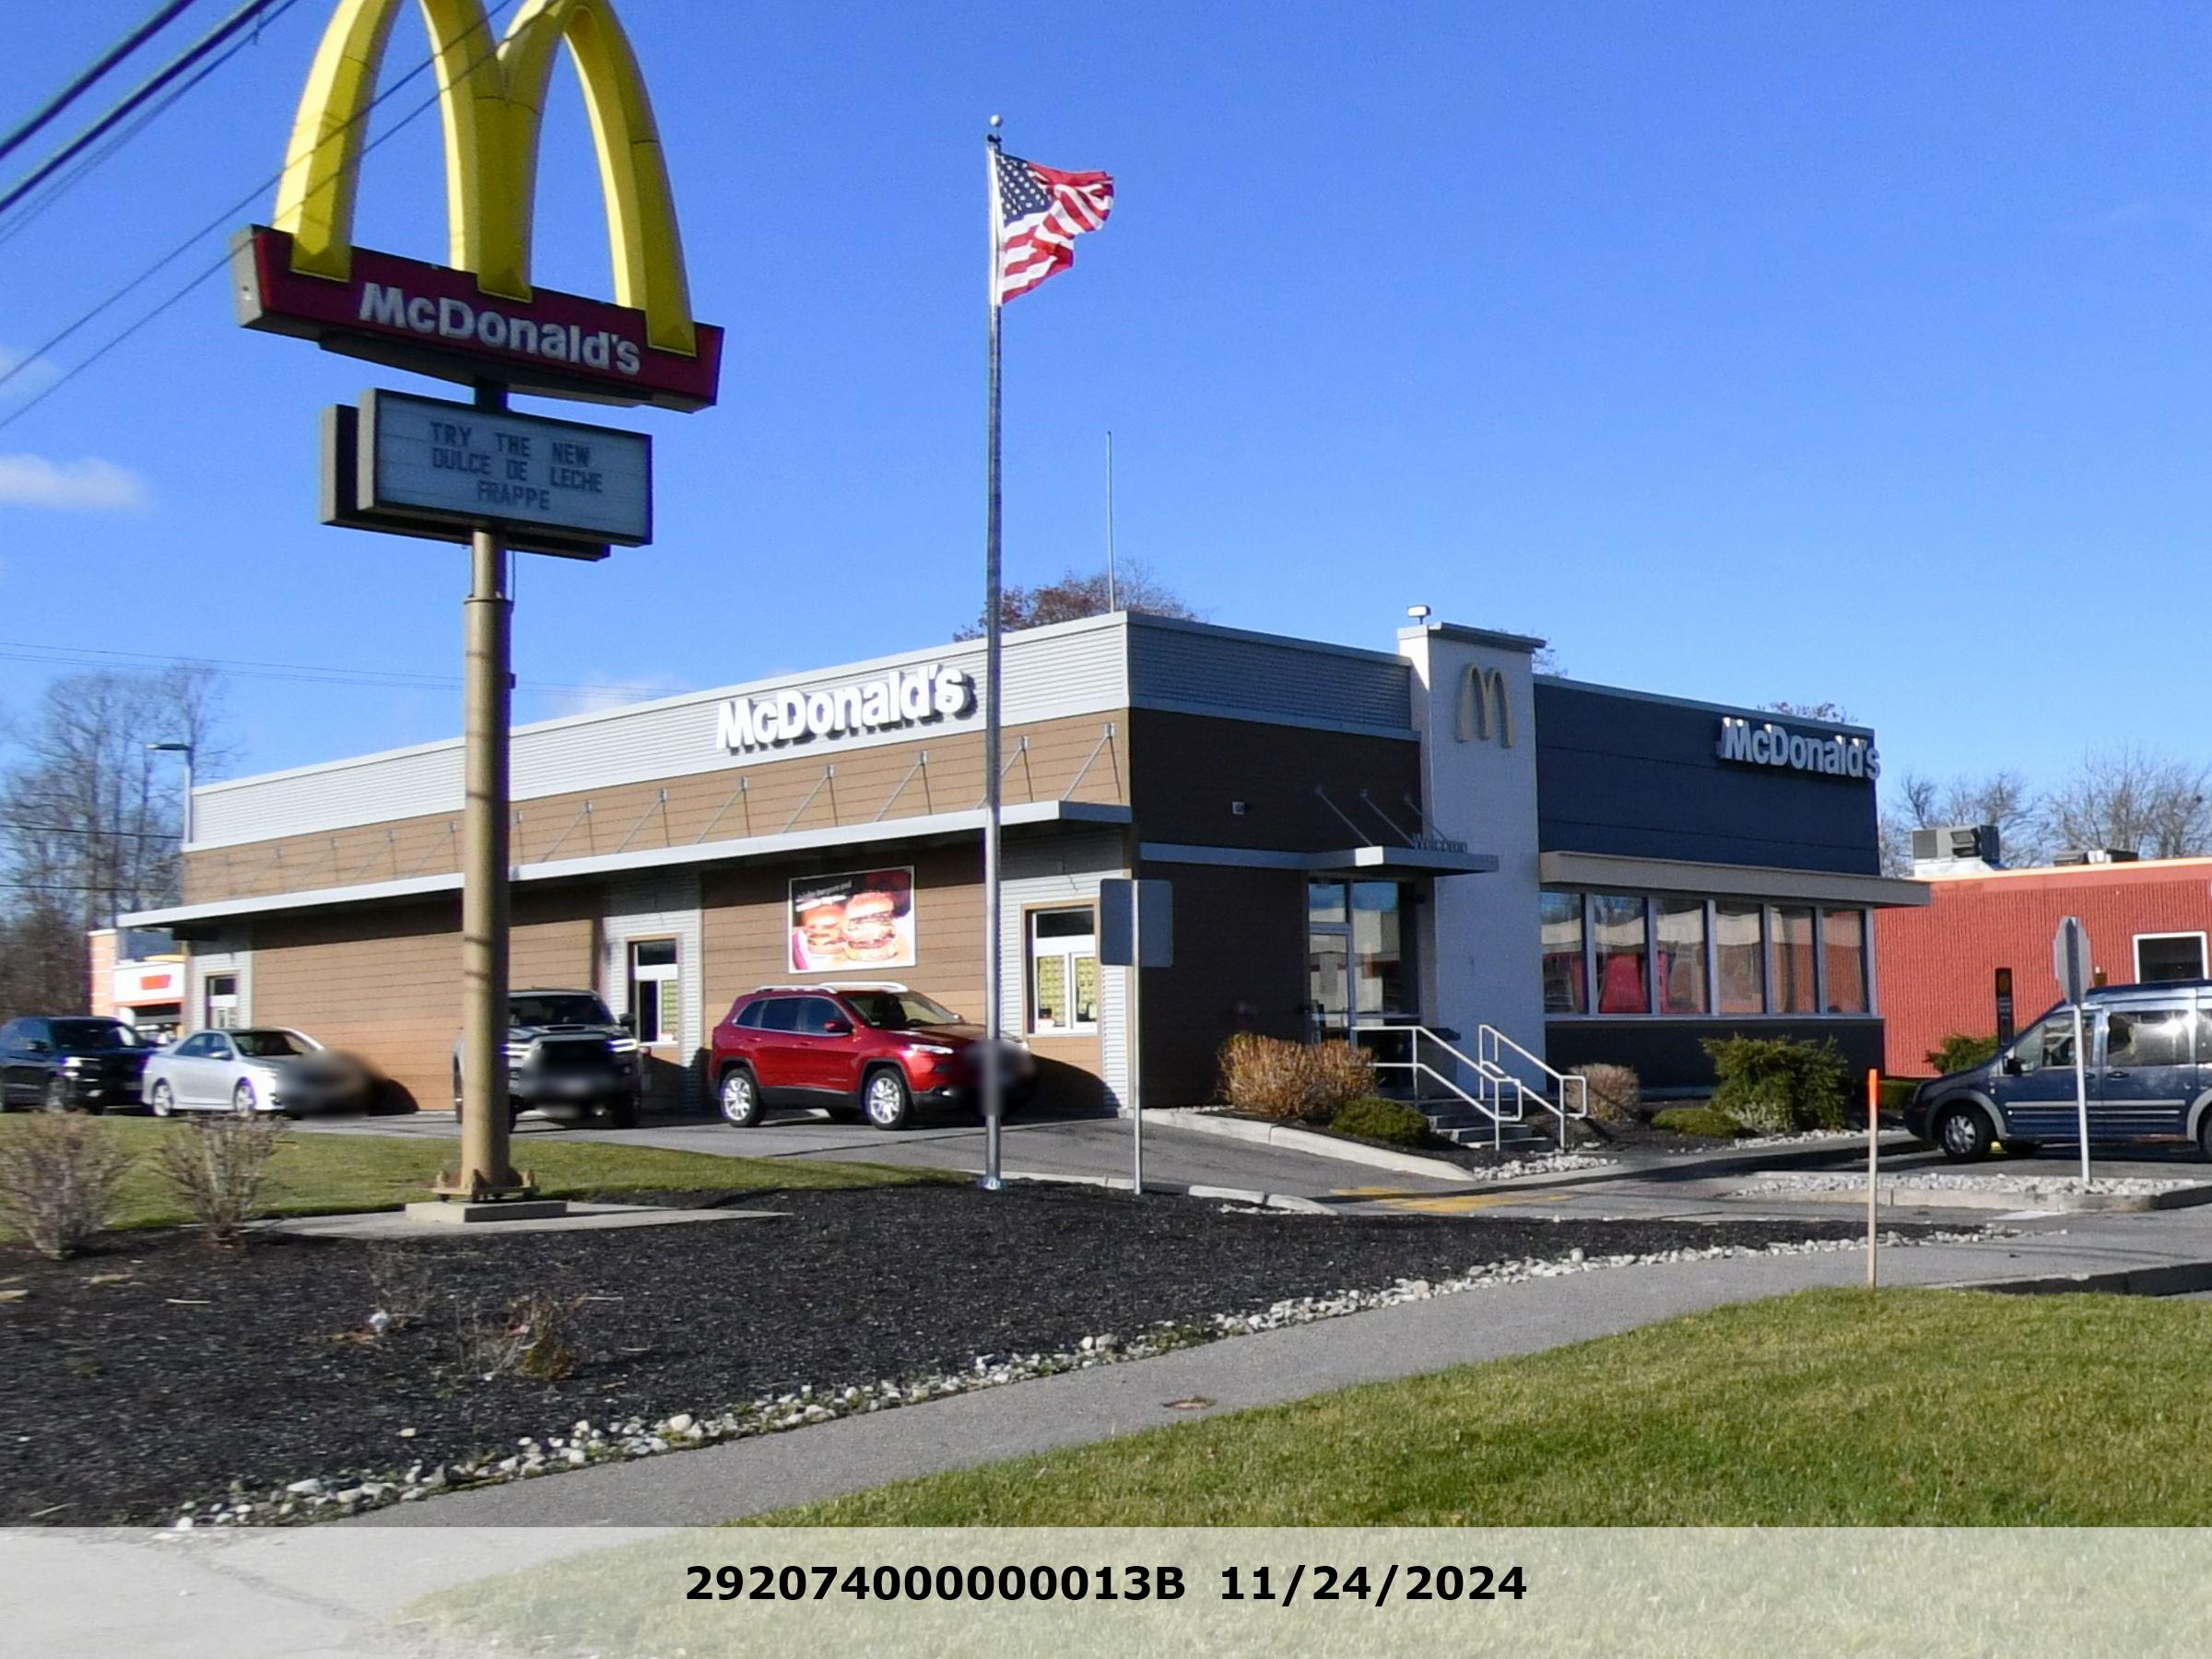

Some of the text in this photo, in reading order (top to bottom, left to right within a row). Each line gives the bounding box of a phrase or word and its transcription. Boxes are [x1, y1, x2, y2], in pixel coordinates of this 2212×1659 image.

[359, 282, 641, 375] McDonald's
[429, 420, 591, 467] TRY THE NEW
[431, 447, 603, 494] DULCE DE LECHE
[477, 479, 550, 511] FRAPPE
[716, 663, 966, 749] McDonald's
[1717, 716, 1881, 781] McDonald's
